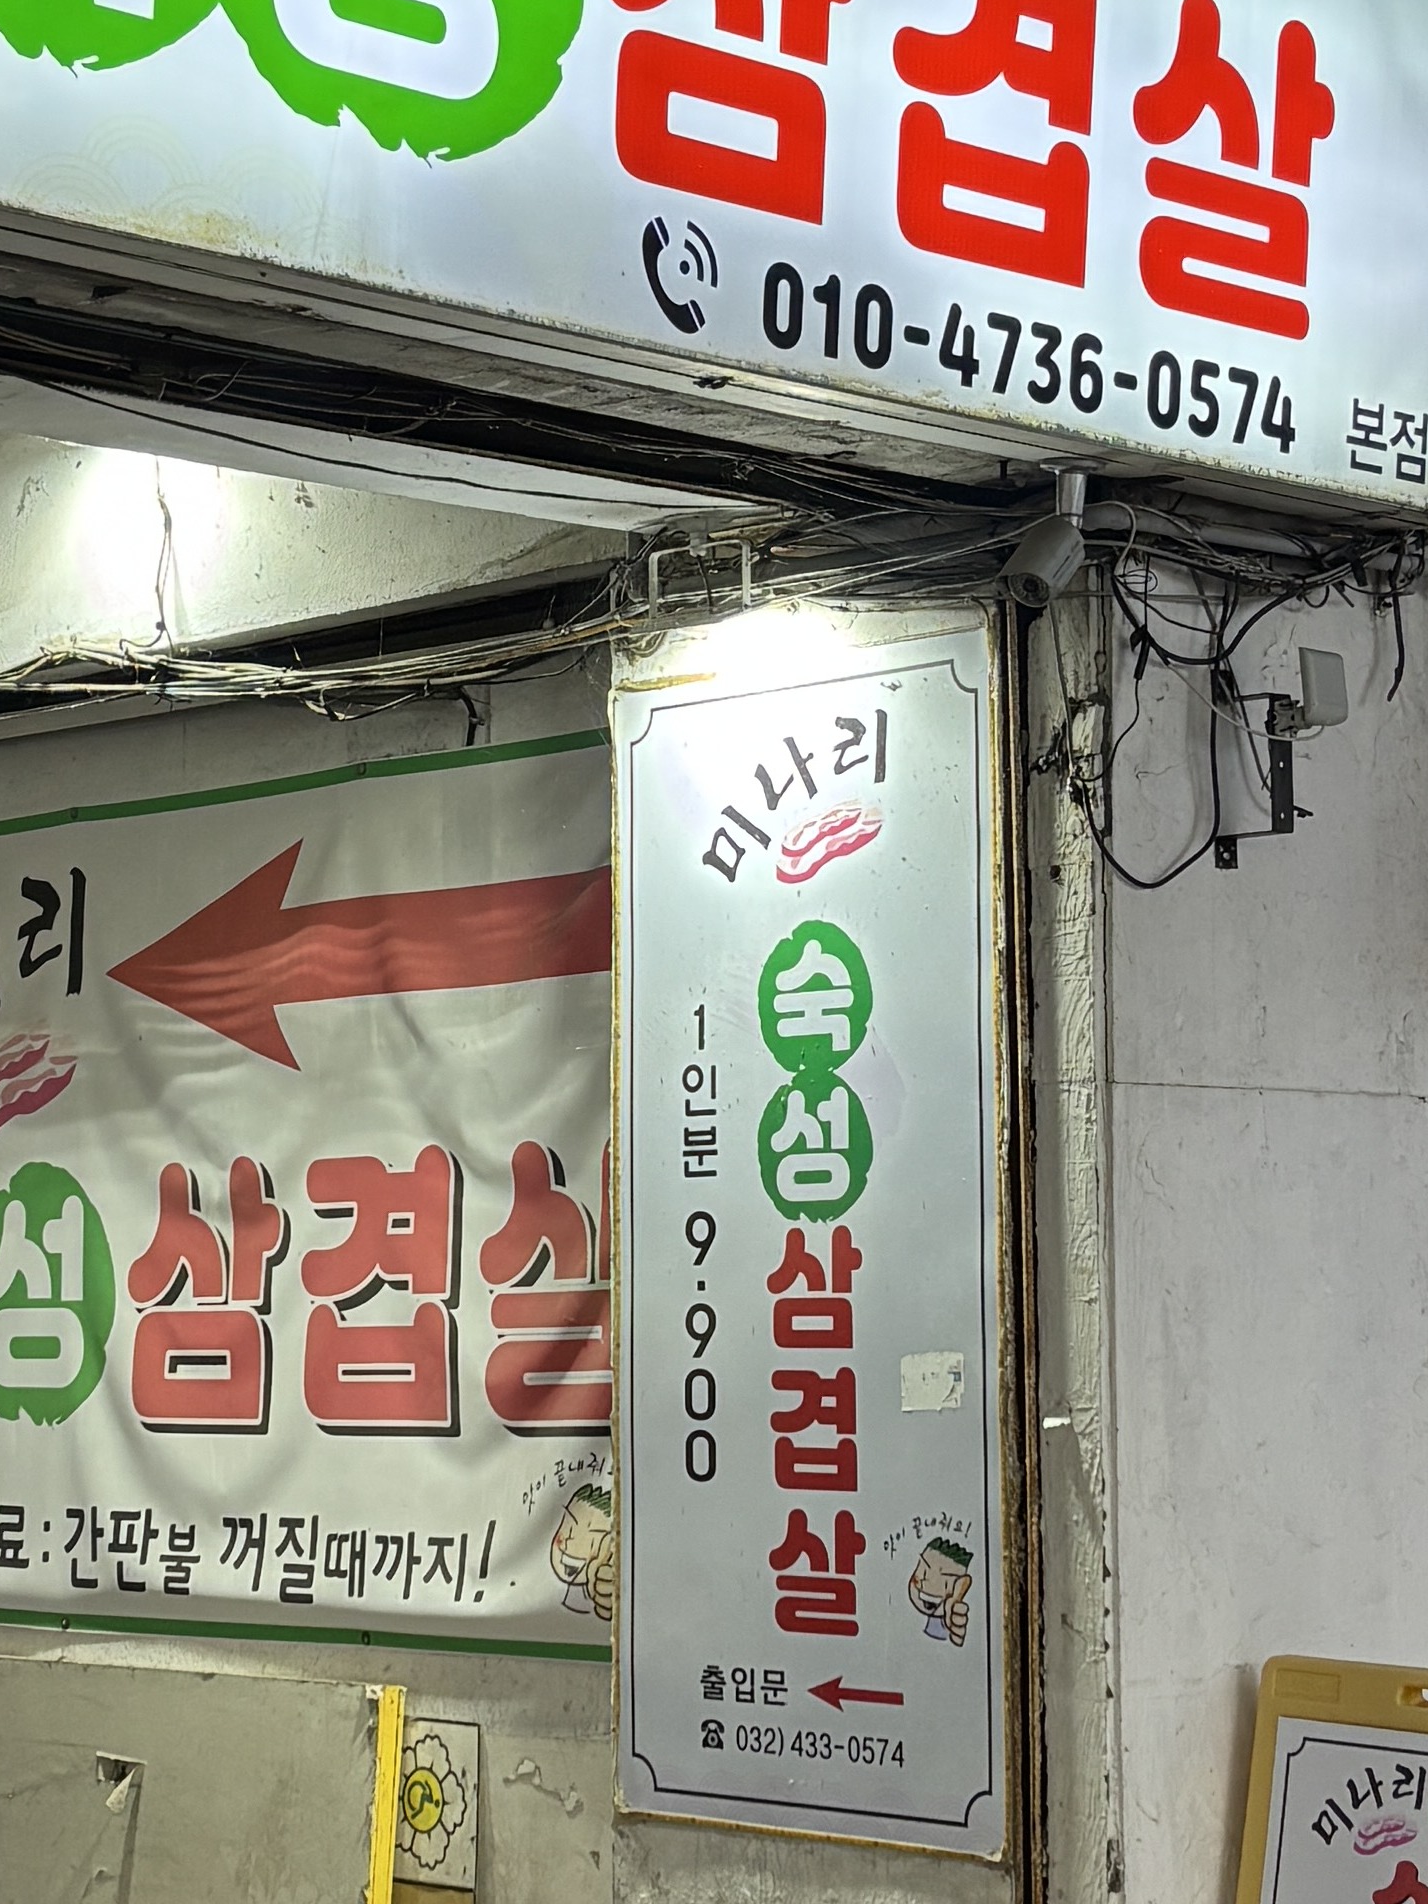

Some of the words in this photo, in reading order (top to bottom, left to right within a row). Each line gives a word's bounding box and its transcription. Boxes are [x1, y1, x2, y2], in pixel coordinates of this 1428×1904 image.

[761, 258, 1297, 456] 010-4736-0574
[701, 708, 888, 883] 미나리
[770, 938, 854, 1203] 숙성
[126, 1139, 611, 1437] 삼겹살
[554, 1451, 613, 1488] 끝내줘
[766, 1224, 866, 1637] 삼겹살
[219, 1512, 494, 1604] 꺼질때까지!
[699, 1664, 789, 1708] 출입문
[1310, 1762, 1428, 1848] 미나리
